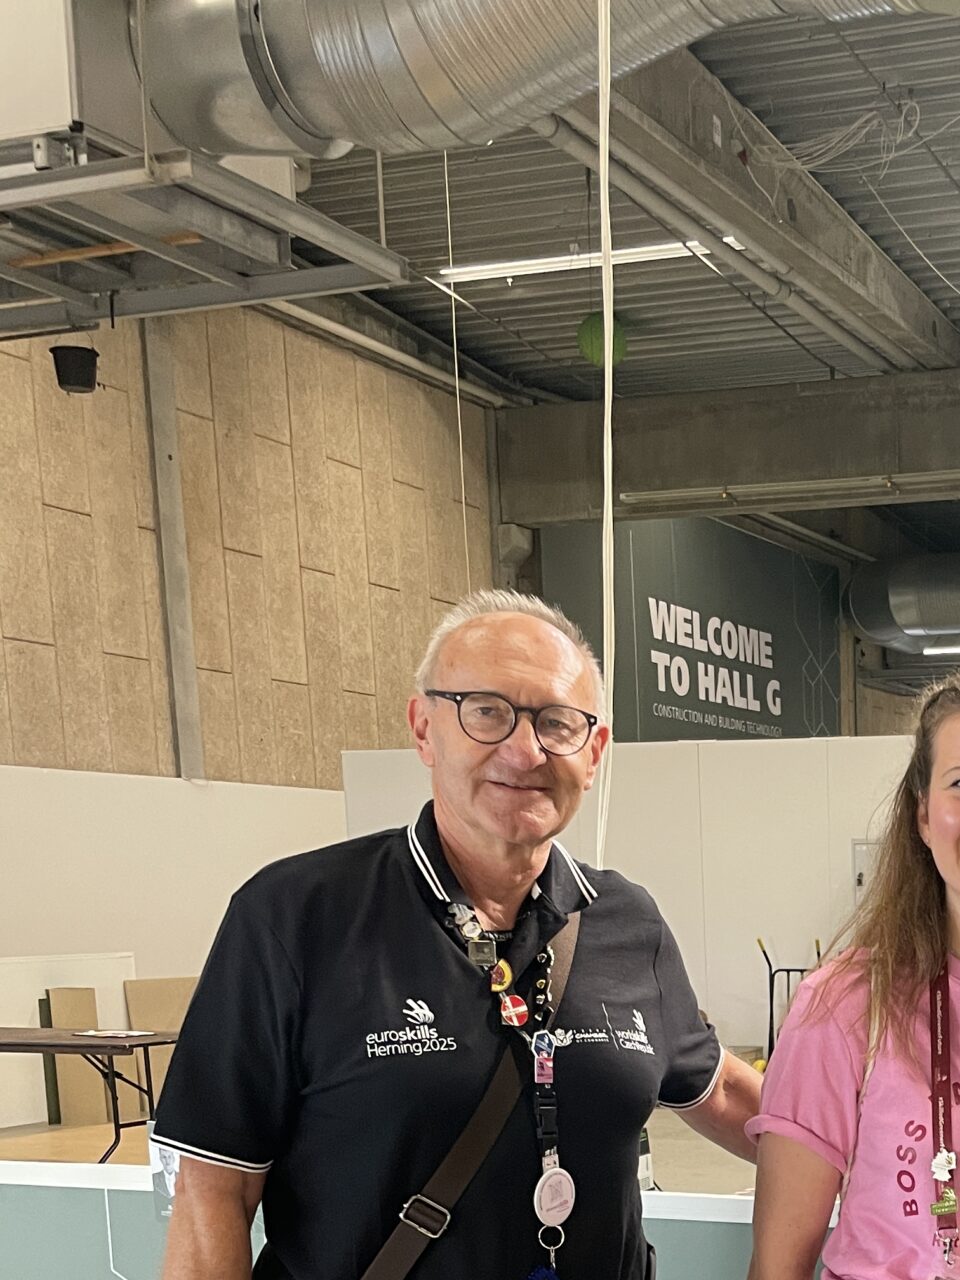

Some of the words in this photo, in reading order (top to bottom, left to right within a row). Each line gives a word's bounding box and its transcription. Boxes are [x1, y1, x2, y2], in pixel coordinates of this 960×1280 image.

[648, 597, 773, 669] WELCOME
[651, 650, 690, 697] TO
[698, 661, 760, 712] HALL
[766, 680, 782, 716] G
[652, 703, 703, 724] CONSTRUCTION
[704, 713, 717, 727] AND
[719, 716, 745, 732] BUILDING
[746, 721, 783, 738] TECHNOLOGY
[366, 1025, 438, 1044] euroskills
[366, 1037, 457, 1058] Herning2025
[896, 1119, 927, 1217] BOSS
